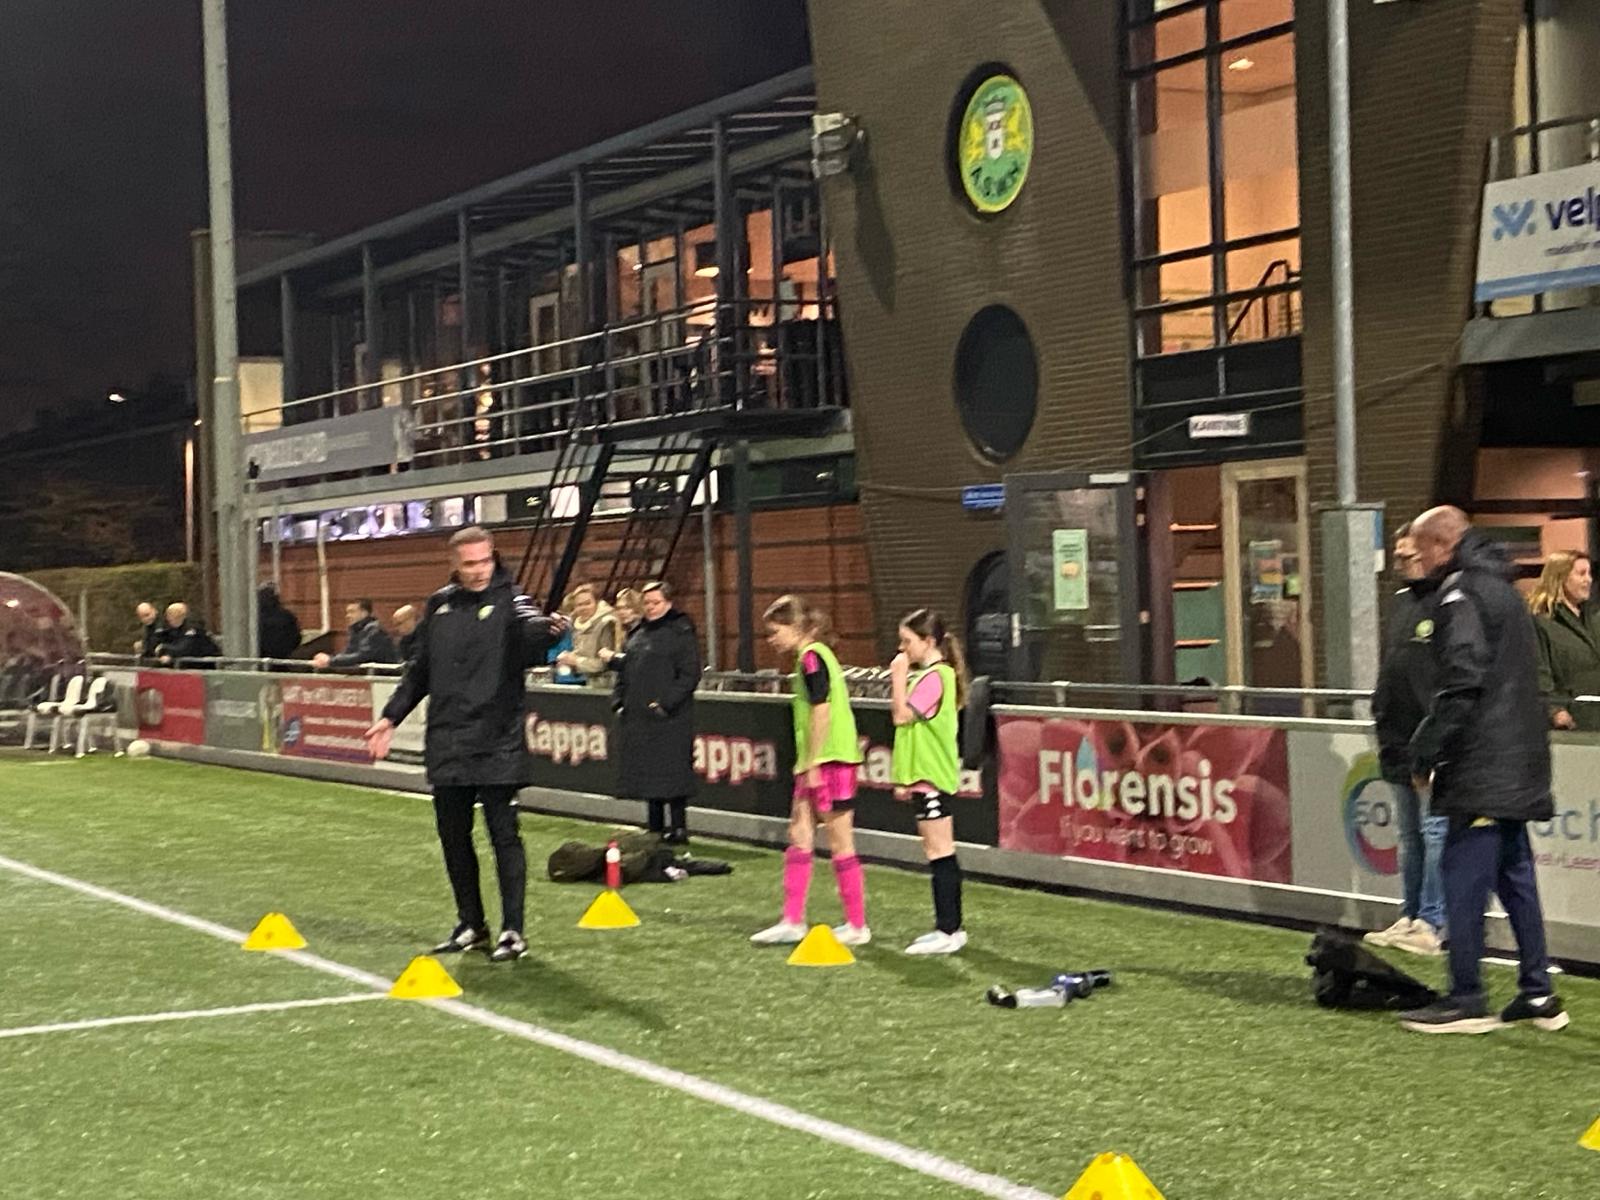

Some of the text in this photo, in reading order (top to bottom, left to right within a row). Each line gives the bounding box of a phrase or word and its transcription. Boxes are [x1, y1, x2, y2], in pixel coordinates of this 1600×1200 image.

[1545, 186, 1600, 231] vel
[692, 735, 777, 783] appa
[1038, 750, 1238, 824] Florensis
[1072, 825, 1103, 847] you
[1169, 834, 1213, 860] grow
